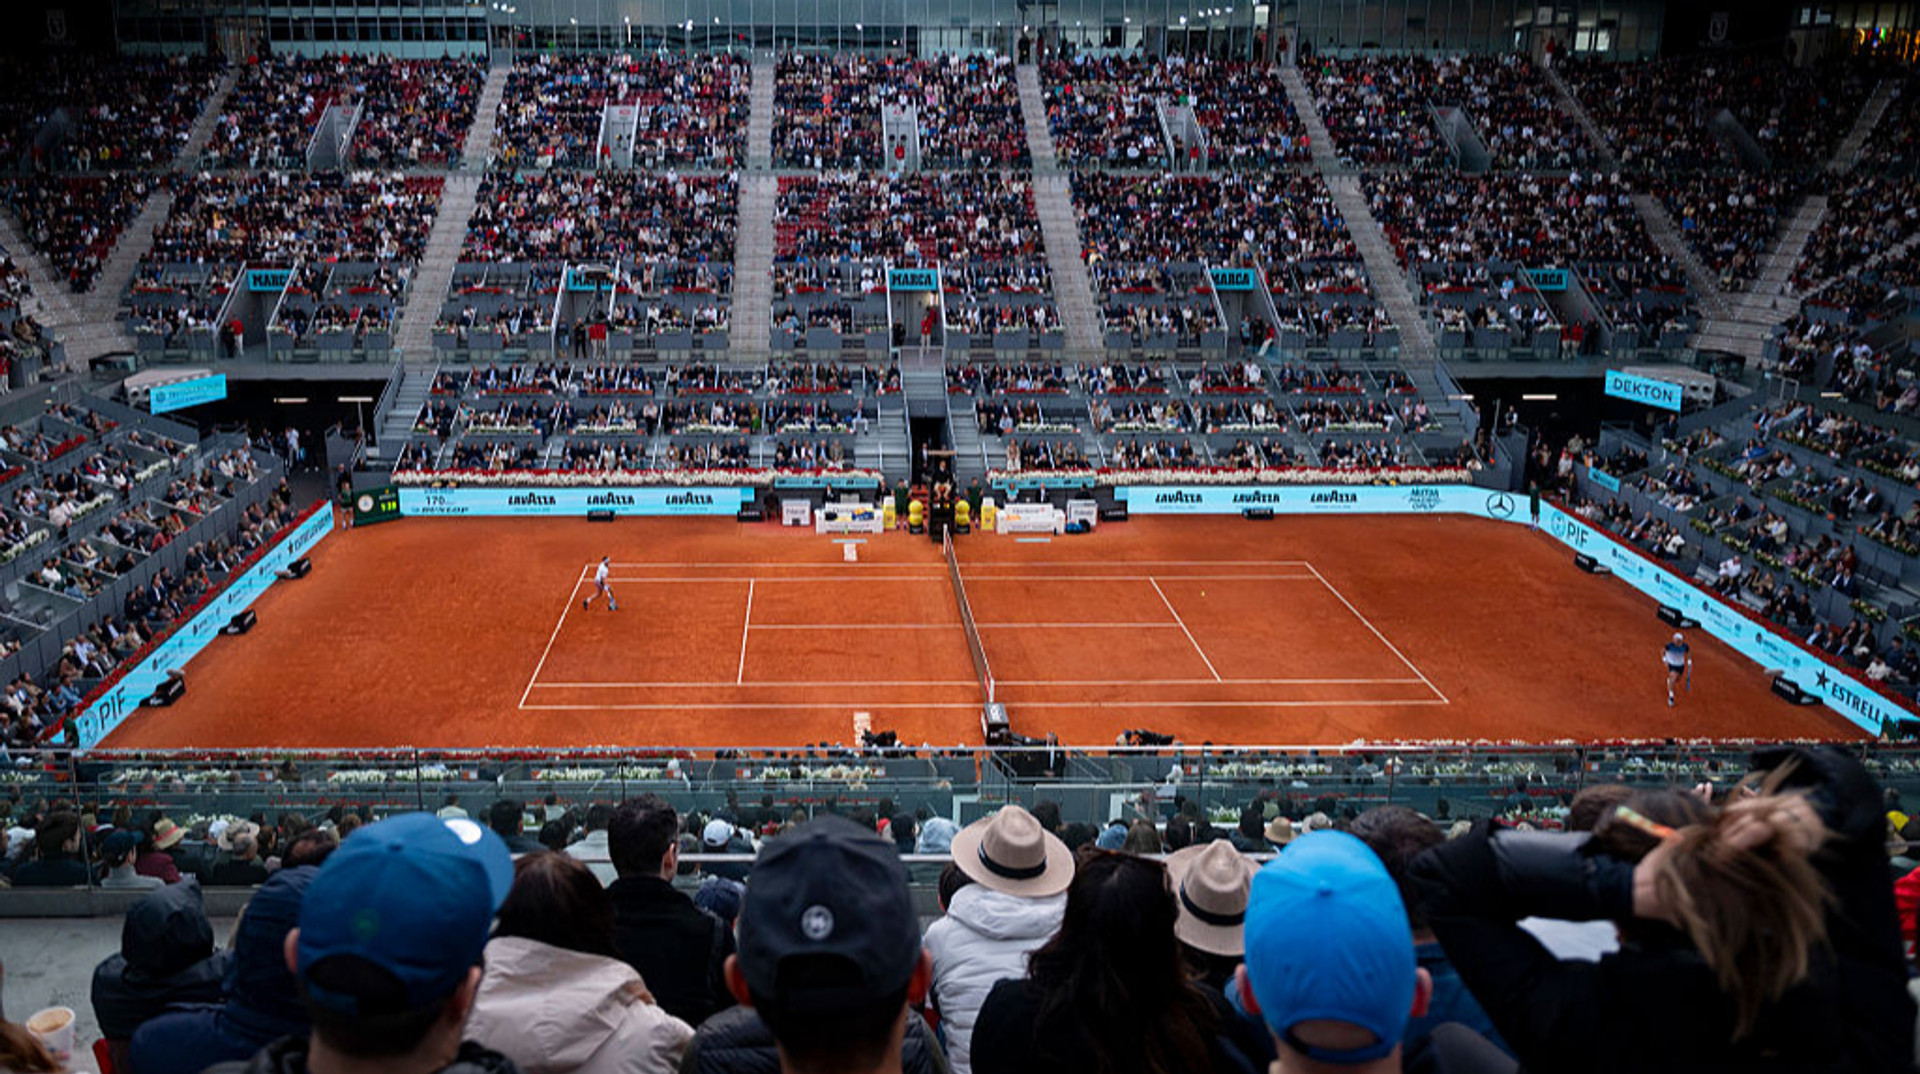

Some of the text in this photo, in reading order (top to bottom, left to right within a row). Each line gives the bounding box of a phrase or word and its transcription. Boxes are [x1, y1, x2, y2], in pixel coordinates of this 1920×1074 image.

[892, 273, 932, 286] MARCA
[1531, 273, 1563, 285] ARCA
[1613, 377, 1674, 403] DEKTON
[508, 492, 556, 505] LAVAZZA
[587, 492, 635, 505] LAVAZZA
[666, 492, 714, 505] LAVAZZA
[1155, 490, 1203, 503] LAVAZZA
[1233, 490, 1280, 503] LAVAZZA
[1310, 490, 1357, 503] LAVAZZA
[1567, 520, 1589, 548] PIF
[99, 685, 125, 731] PIF
[1832, 682, 1882, 725] ESTRELL
